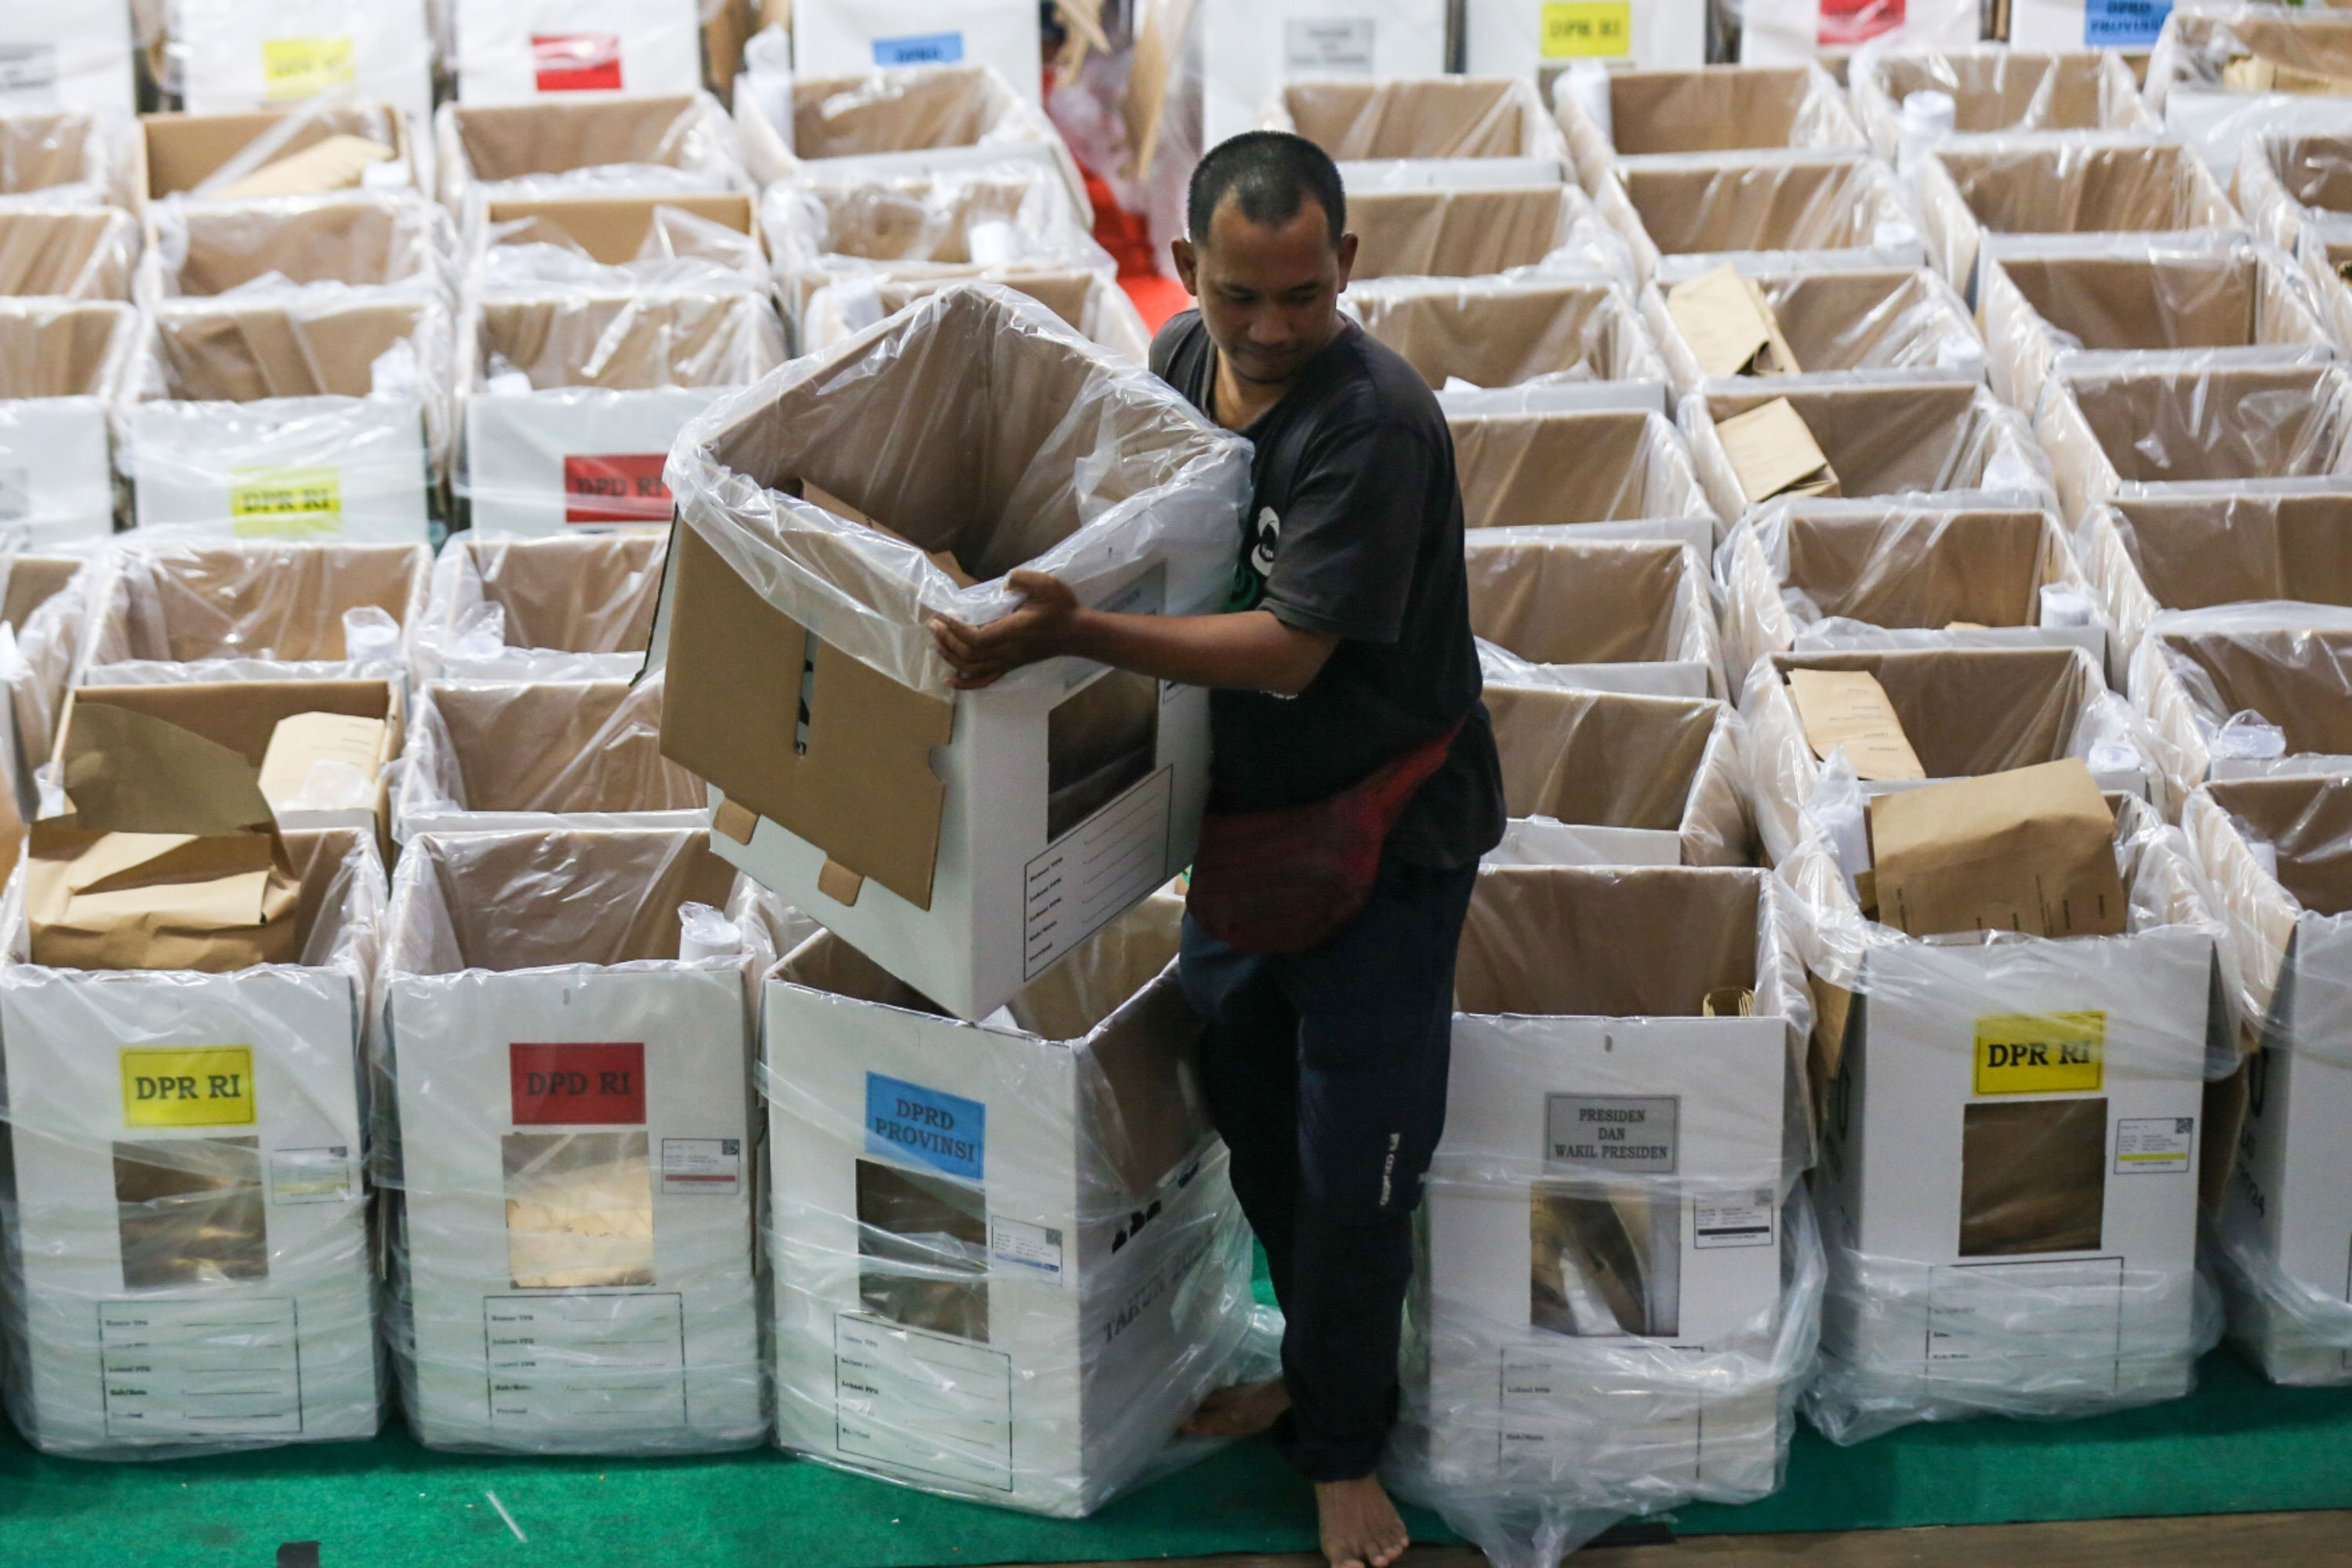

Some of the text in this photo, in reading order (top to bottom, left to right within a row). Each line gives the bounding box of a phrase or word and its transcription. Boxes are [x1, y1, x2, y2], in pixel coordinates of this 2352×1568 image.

[576, 477, 627, 498] DPD
[242, 489, 294, 511] DPR
[1987, 1040, 2091, 1068] DPR RI
[136, 1074, 241, 1100] DPR RI
[527, 1071, 631, 1096] DPD RI
[896, 1098, 955, 1131] DPRD
[1578, 1109, 1646, 1123] PRESIDEN
[875, 1116, 975, 1163] PROVINSI
[1598, 1127, 1626, 1140] DAN
[1555, 1144, 1668, 1159] WAKIL PRESIDEN
